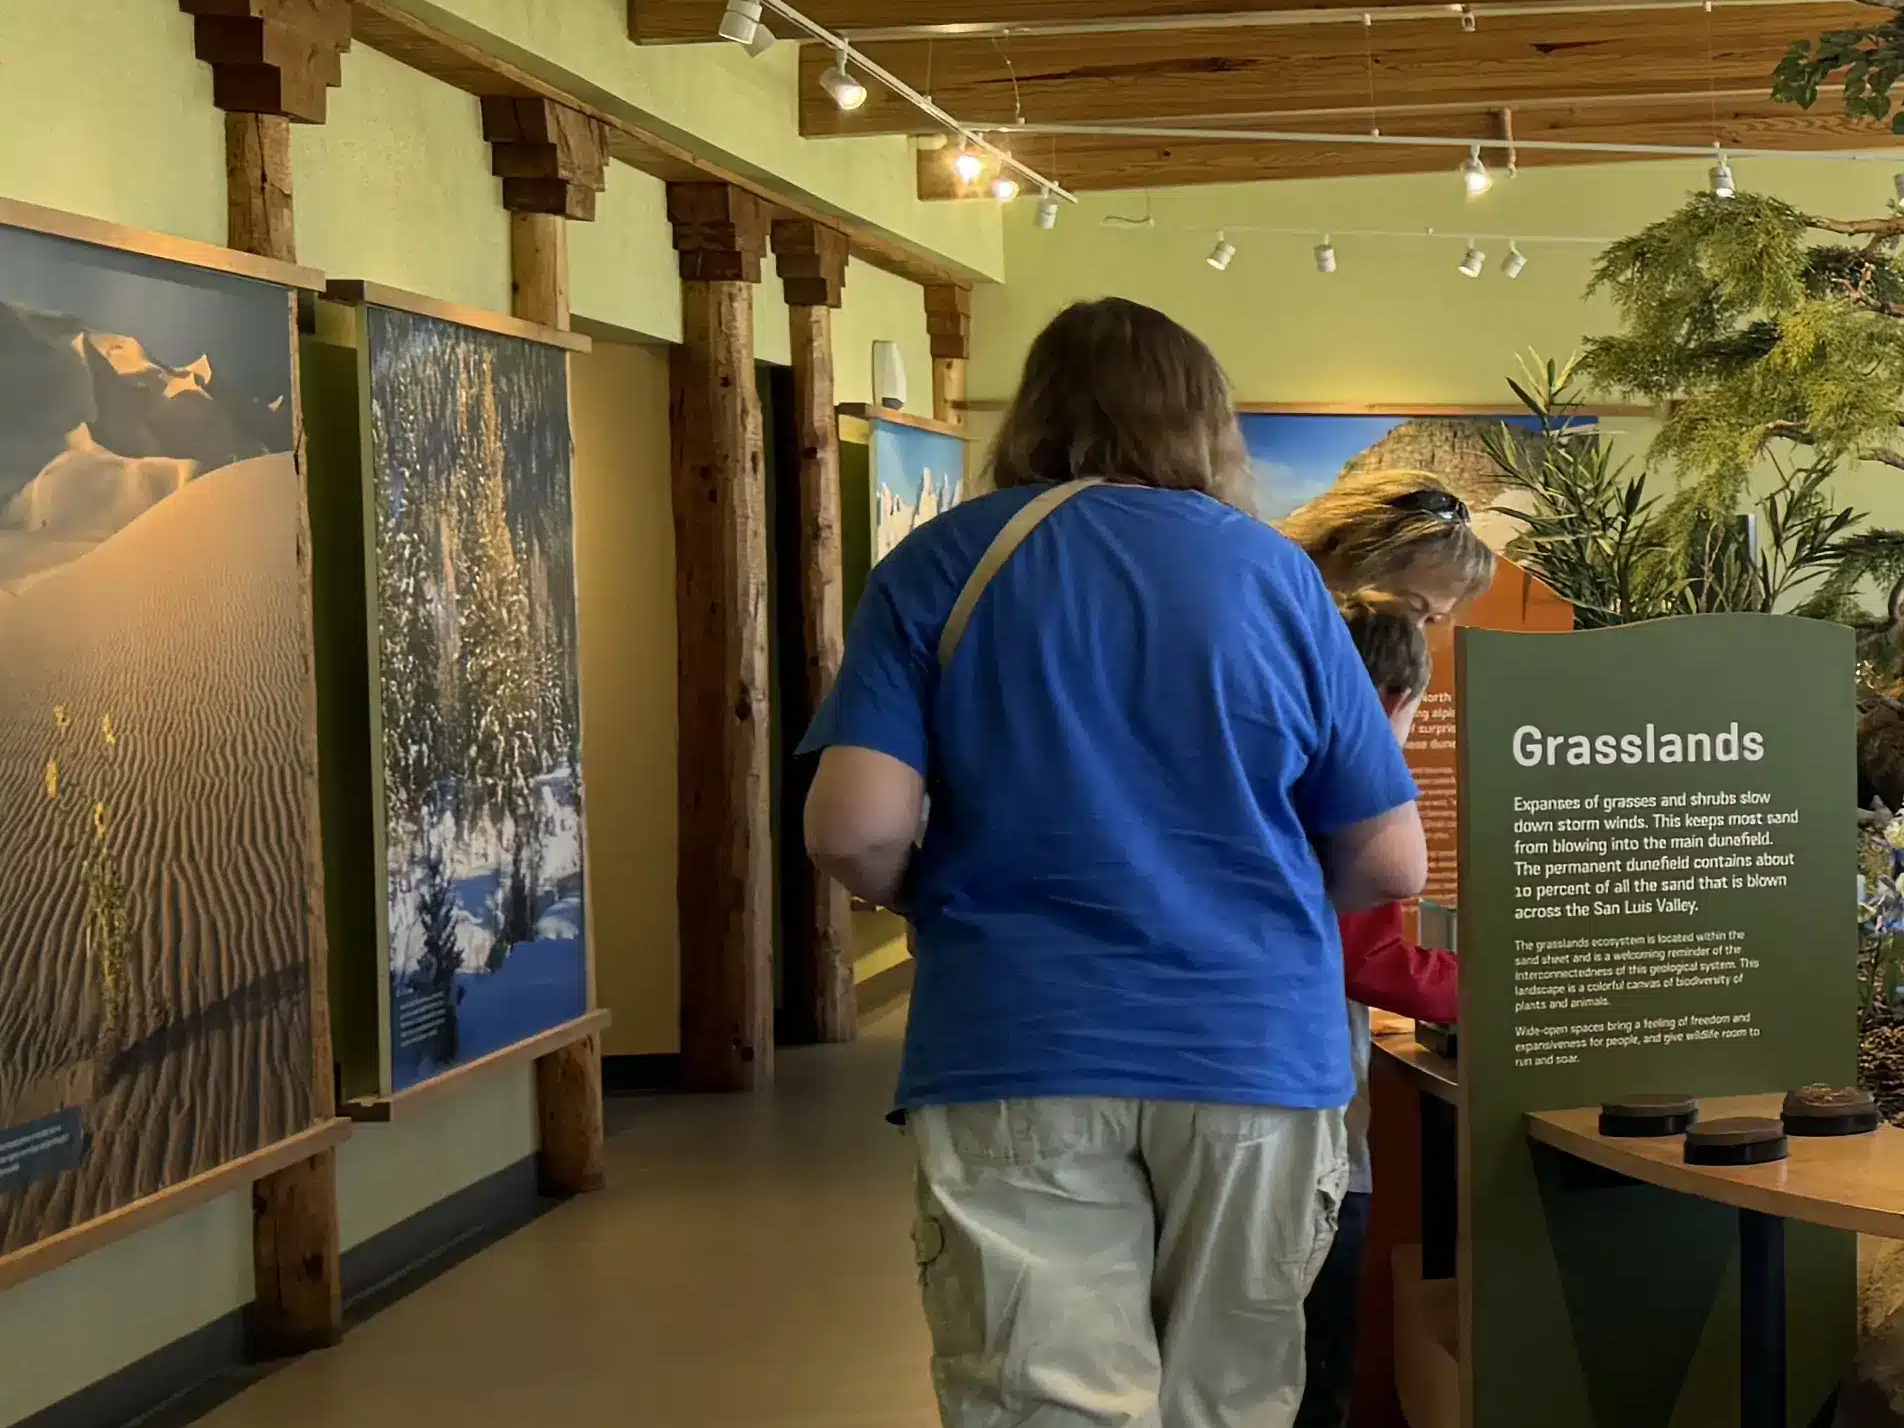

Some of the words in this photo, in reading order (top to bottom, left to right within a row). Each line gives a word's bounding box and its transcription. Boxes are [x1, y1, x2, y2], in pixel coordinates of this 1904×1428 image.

[1512, 721, 1765, 767] Grasslands
[1514, 796, 1580, 814] Expanses
[1584, 794, 1599, 808] of
[1603, 796, 1656, 812] grasses
[1660, 792, 1686, 806] and
[1690, 790, 1736, 805] shrubs
[1739, 790, 1770, 803] slow
[1514, 819, 1552, 832] down
[1557, 818, 1599, 831] storm
[1604, 815, 1648, 829] winds.
[1652, 813, 1680, 827] This
[1685, 813, 1724, 830] keeps
[1728, 813, 1763, 825] most
[1766, 809, 1798, 824] sand
[1514, 839, 1548, 853] from
[1552, 837, 1606, 855] blowing
[1611, 837, 1638, 850] into
[1643, 836, 1666, 849] the
[1670, 834, 1703, 848] main
[1708, 831, 1773, 847] dunefield.
[1513, 861, 1540, 875] The
[1545, 859, 1621, 878] permanent
[1626, 855, 1689, 871] dunefield
[1693, 853, 1752, 868] contains
[1756, 852, 1794, 865] about
[1515, 886, 1531, 897] 10
[1536, 882, 1590, 900] percent
[1595, 879, 1609, 893] of
[1614, 878, 1629, 893] all
[1633, 878, 1657, 892] the
[1661, 876, 1694, 891] sand
[1697, 875, 1728, 889] that
[1732, 874, 1742, 888] is
[1747, 873, 1786, 887] blown
[1514, 906, 1561, 919] across
[1565, 902, 1589, 916] the
[1594, 901, 1620, 915] San
[1624, 900, 1652, 913] Luis
[1656, 898, 1698, 914] Valley.
